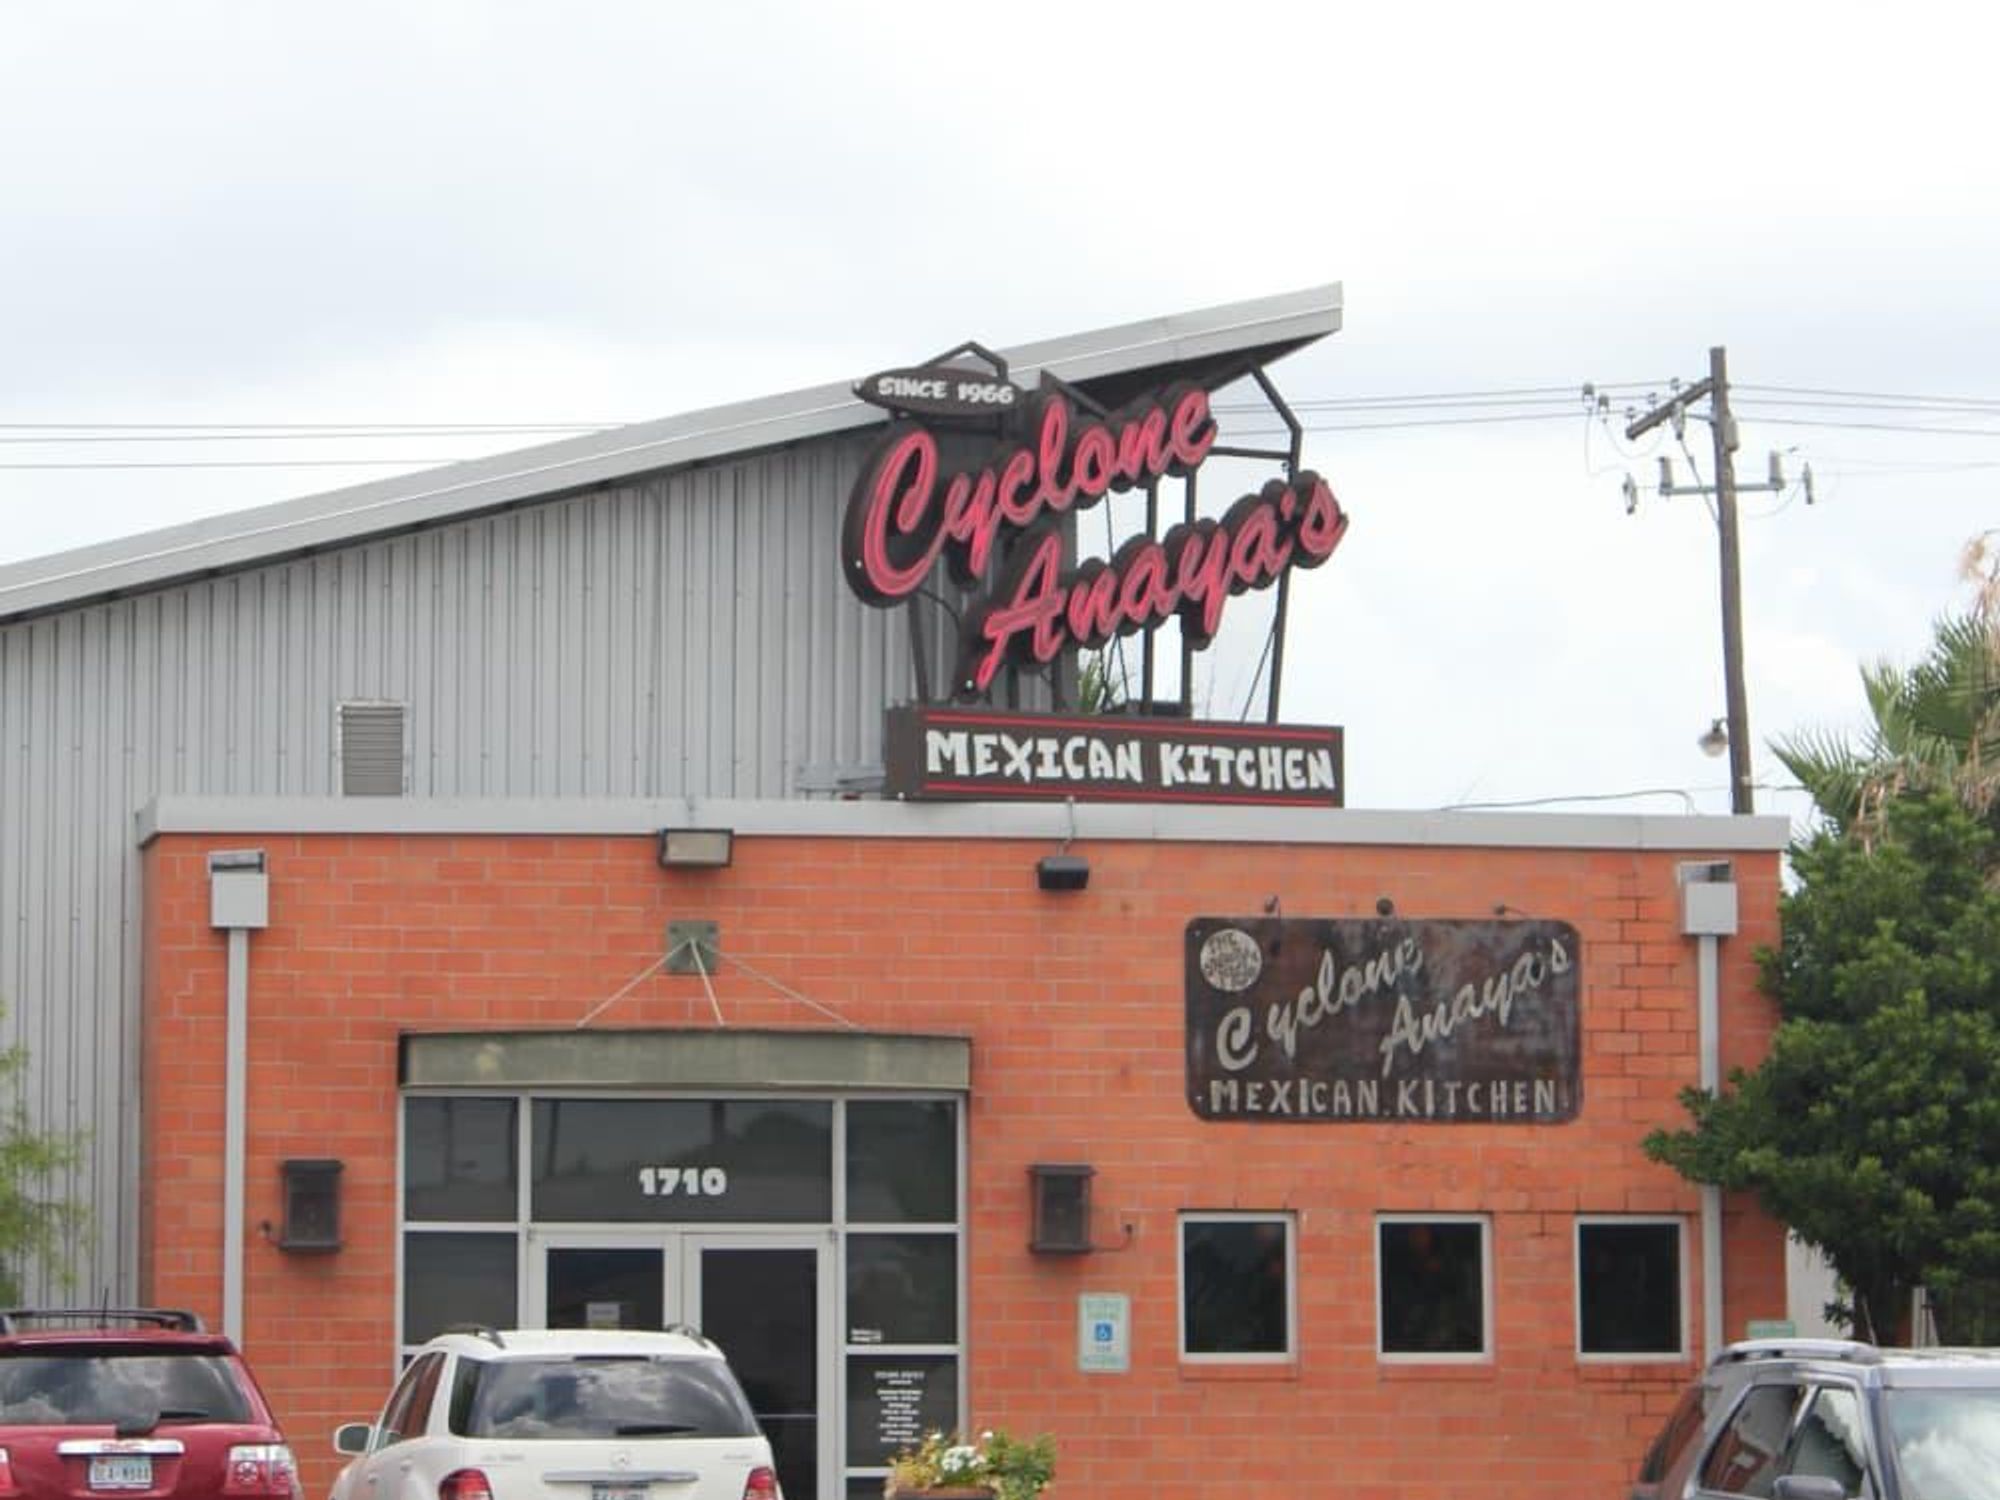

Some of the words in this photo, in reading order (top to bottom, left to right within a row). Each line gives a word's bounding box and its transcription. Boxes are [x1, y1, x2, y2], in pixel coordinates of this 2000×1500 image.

[878, 377, 948, 399] SINCE
[957, 382, 1014, 404] 1966
[863, 390, 1217, 597] Cyclone
[975, 476, 1347, 691] Anaya's
[925, 730, 1144, 783] MEXICAN
[1159, 742, 1336, 791] KITCHEN
[1216, 937, 1423, 1071] Cyclone
[1379, 937, 1570, 1079] Anaya's
[1210, 1079, 1379, 1115] MEXICAN
[1398, 1079, 1556, 1117] KITCHEN
[638, 1167, 728, 1196] 1710
